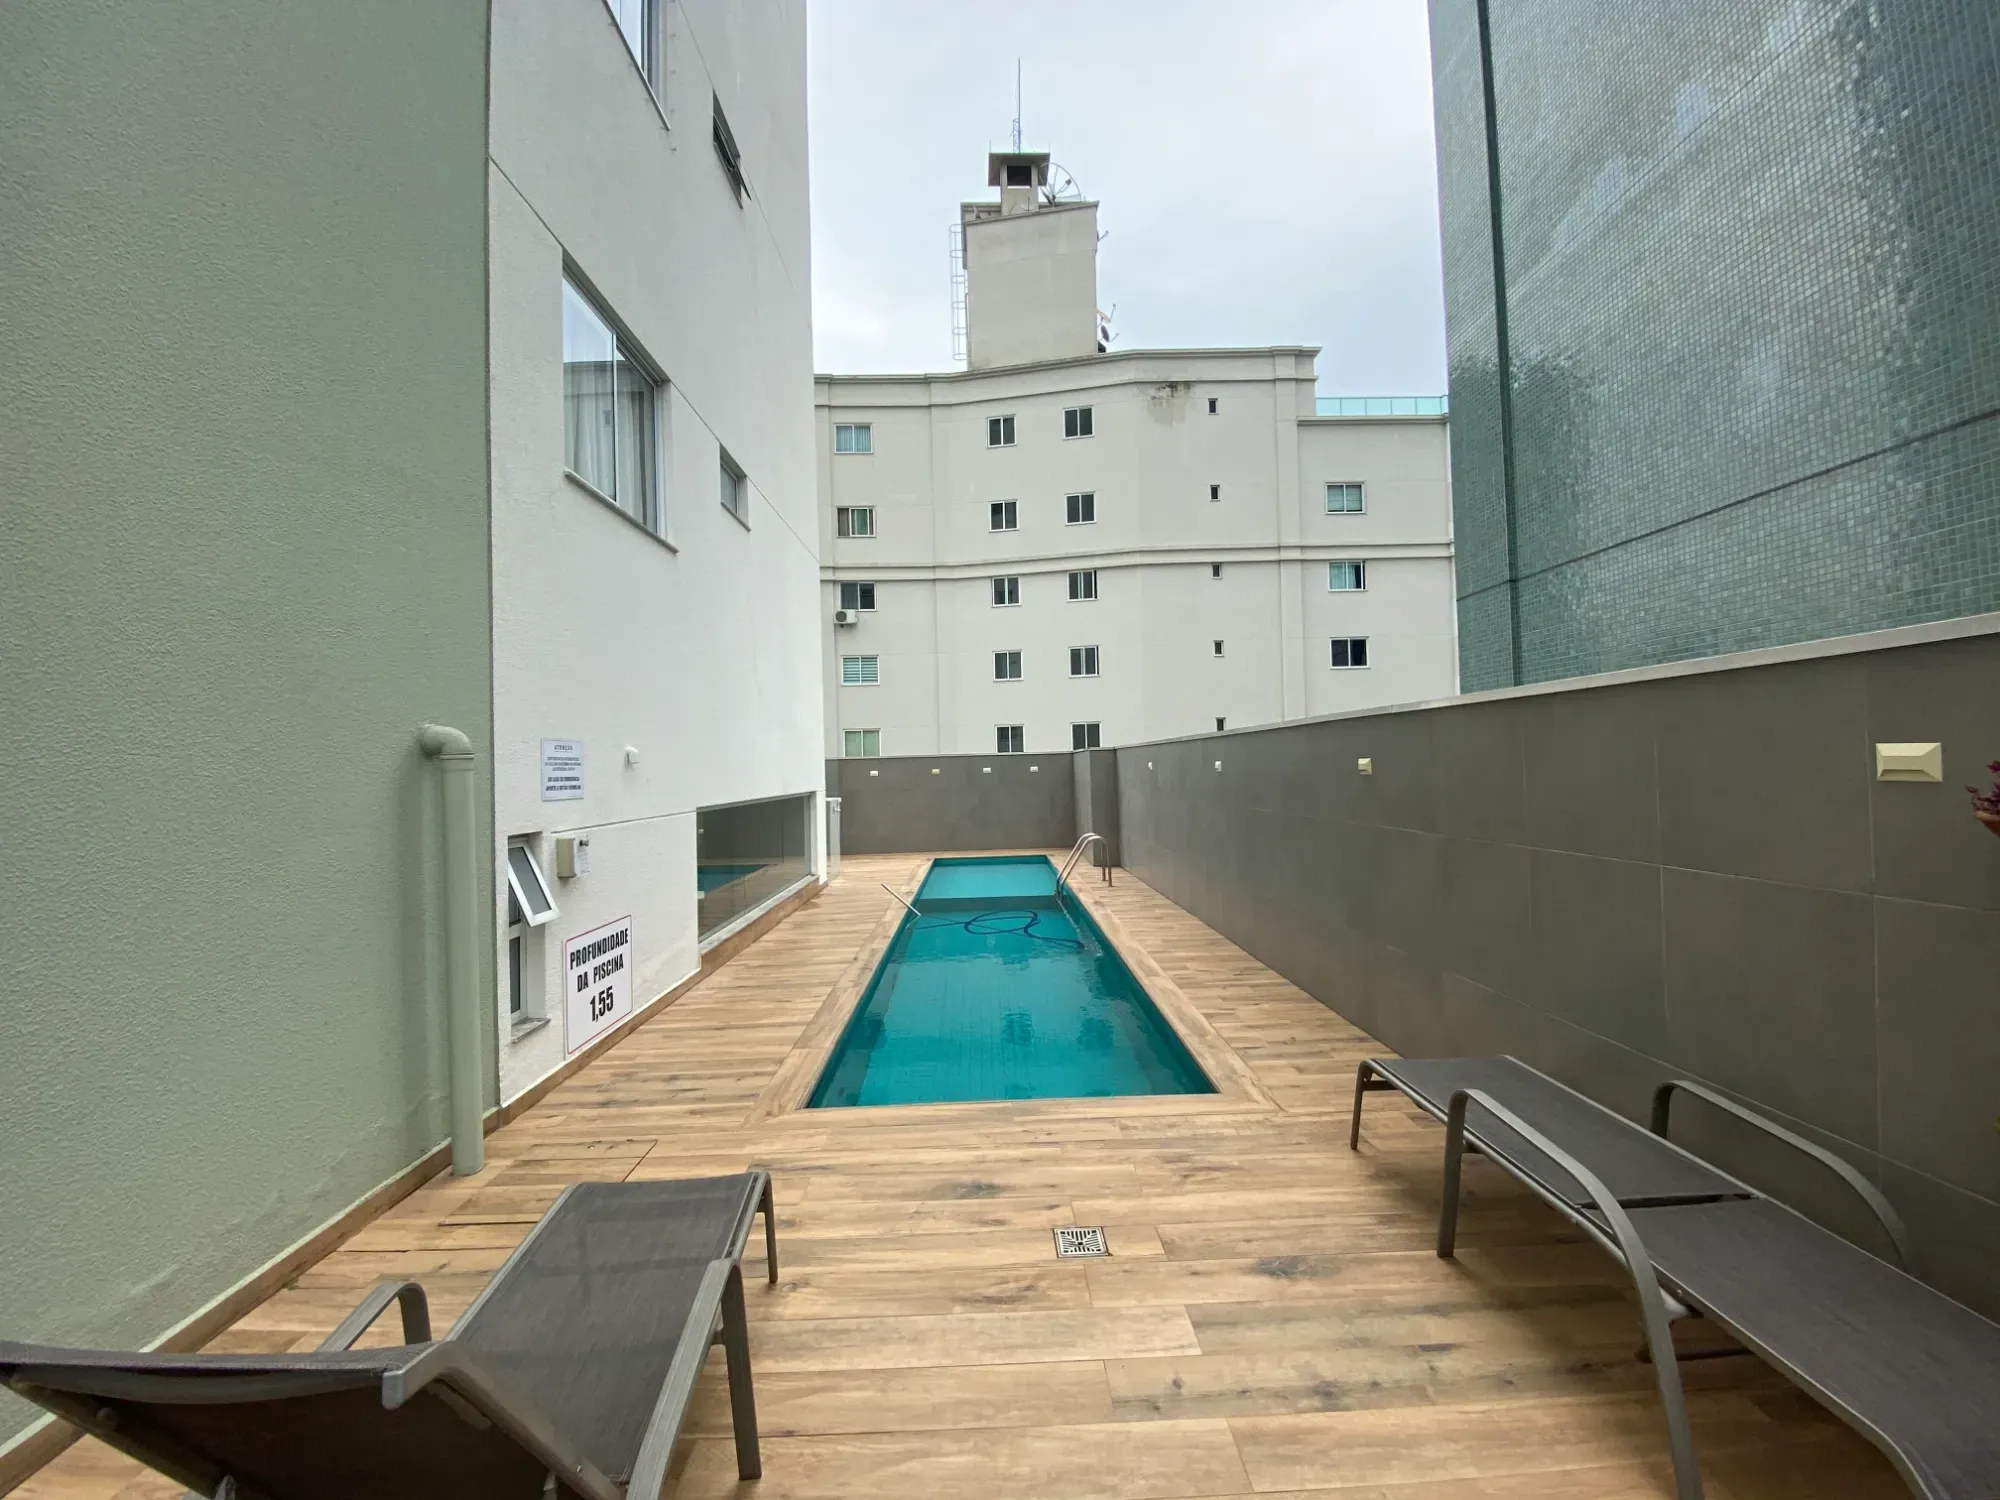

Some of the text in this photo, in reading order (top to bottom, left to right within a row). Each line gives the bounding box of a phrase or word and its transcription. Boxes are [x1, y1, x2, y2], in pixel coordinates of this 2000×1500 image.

[570, 928, 629, 970] PROFUNDIDADE
[577, 953, 624, 993] DA PISCINA
[590, 985, 614, 1022] 1,55
